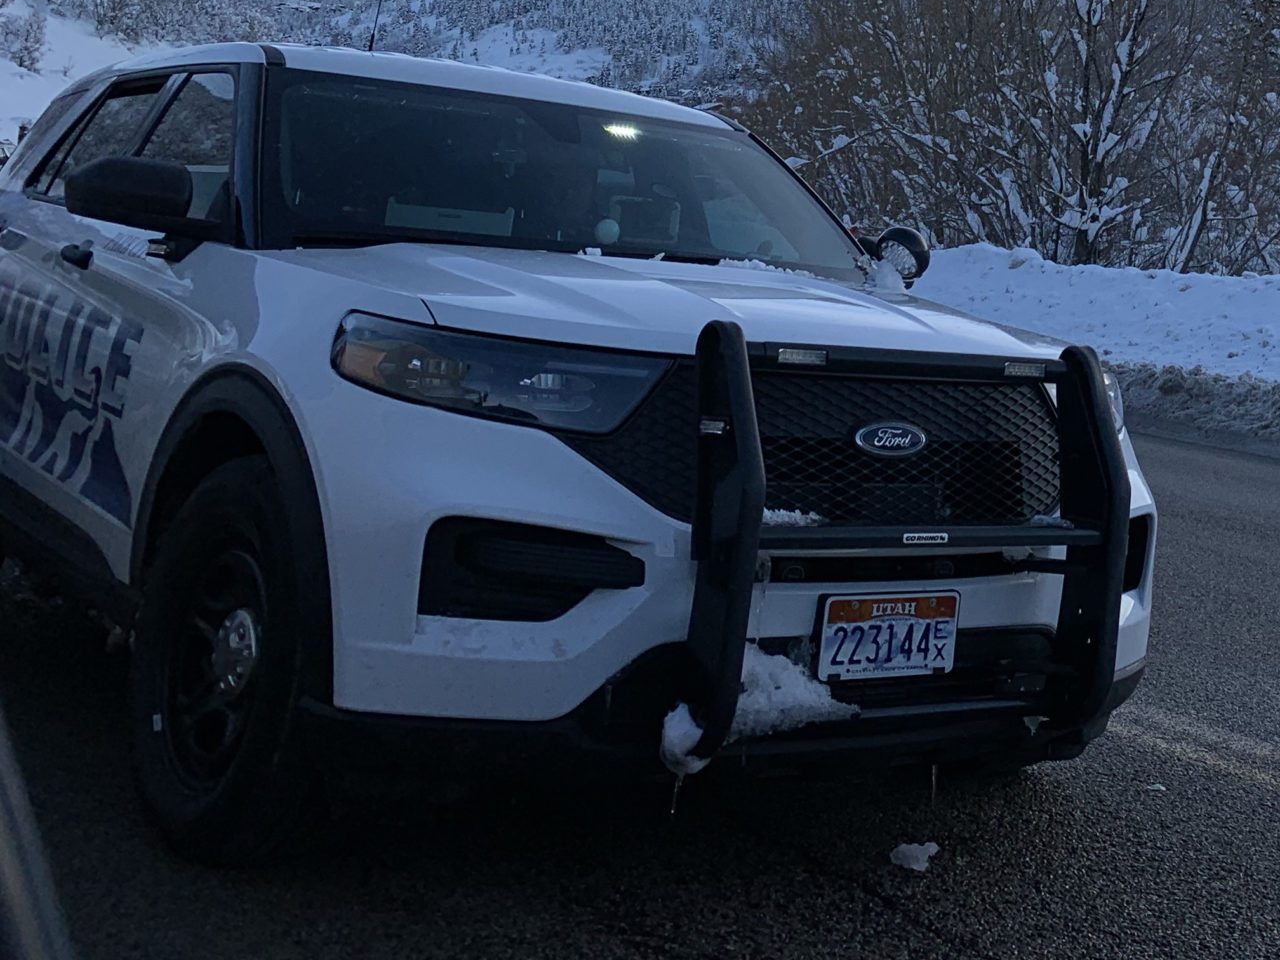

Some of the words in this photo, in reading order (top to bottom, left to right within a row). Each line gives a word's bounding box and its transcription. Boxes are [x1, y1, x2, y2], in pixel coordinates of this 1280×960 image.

[0, 277, 144, 418] OLICE
[873, 428, 912, 447] Ford
[871, 602, 917, 617] UTAH
[830, 621, 932, 666] 223144
